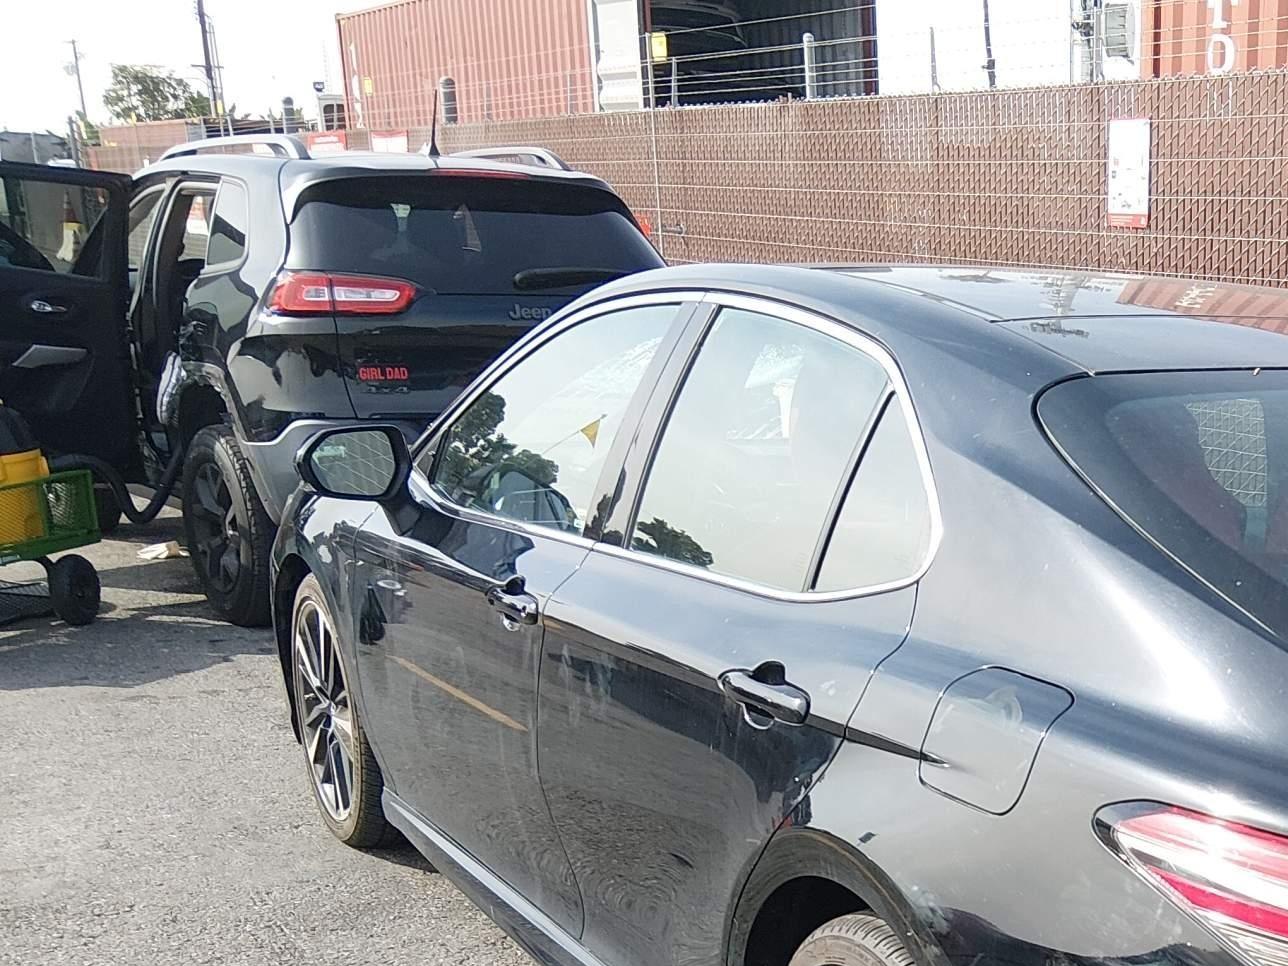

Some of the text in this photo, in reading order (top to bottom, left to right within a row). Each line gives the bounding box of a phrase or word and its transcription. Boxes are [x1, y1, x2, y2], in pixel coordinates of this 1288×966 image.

[509, 303, 552, 321] Jeep
[358, 366, 409, 380] GIRL DAD
